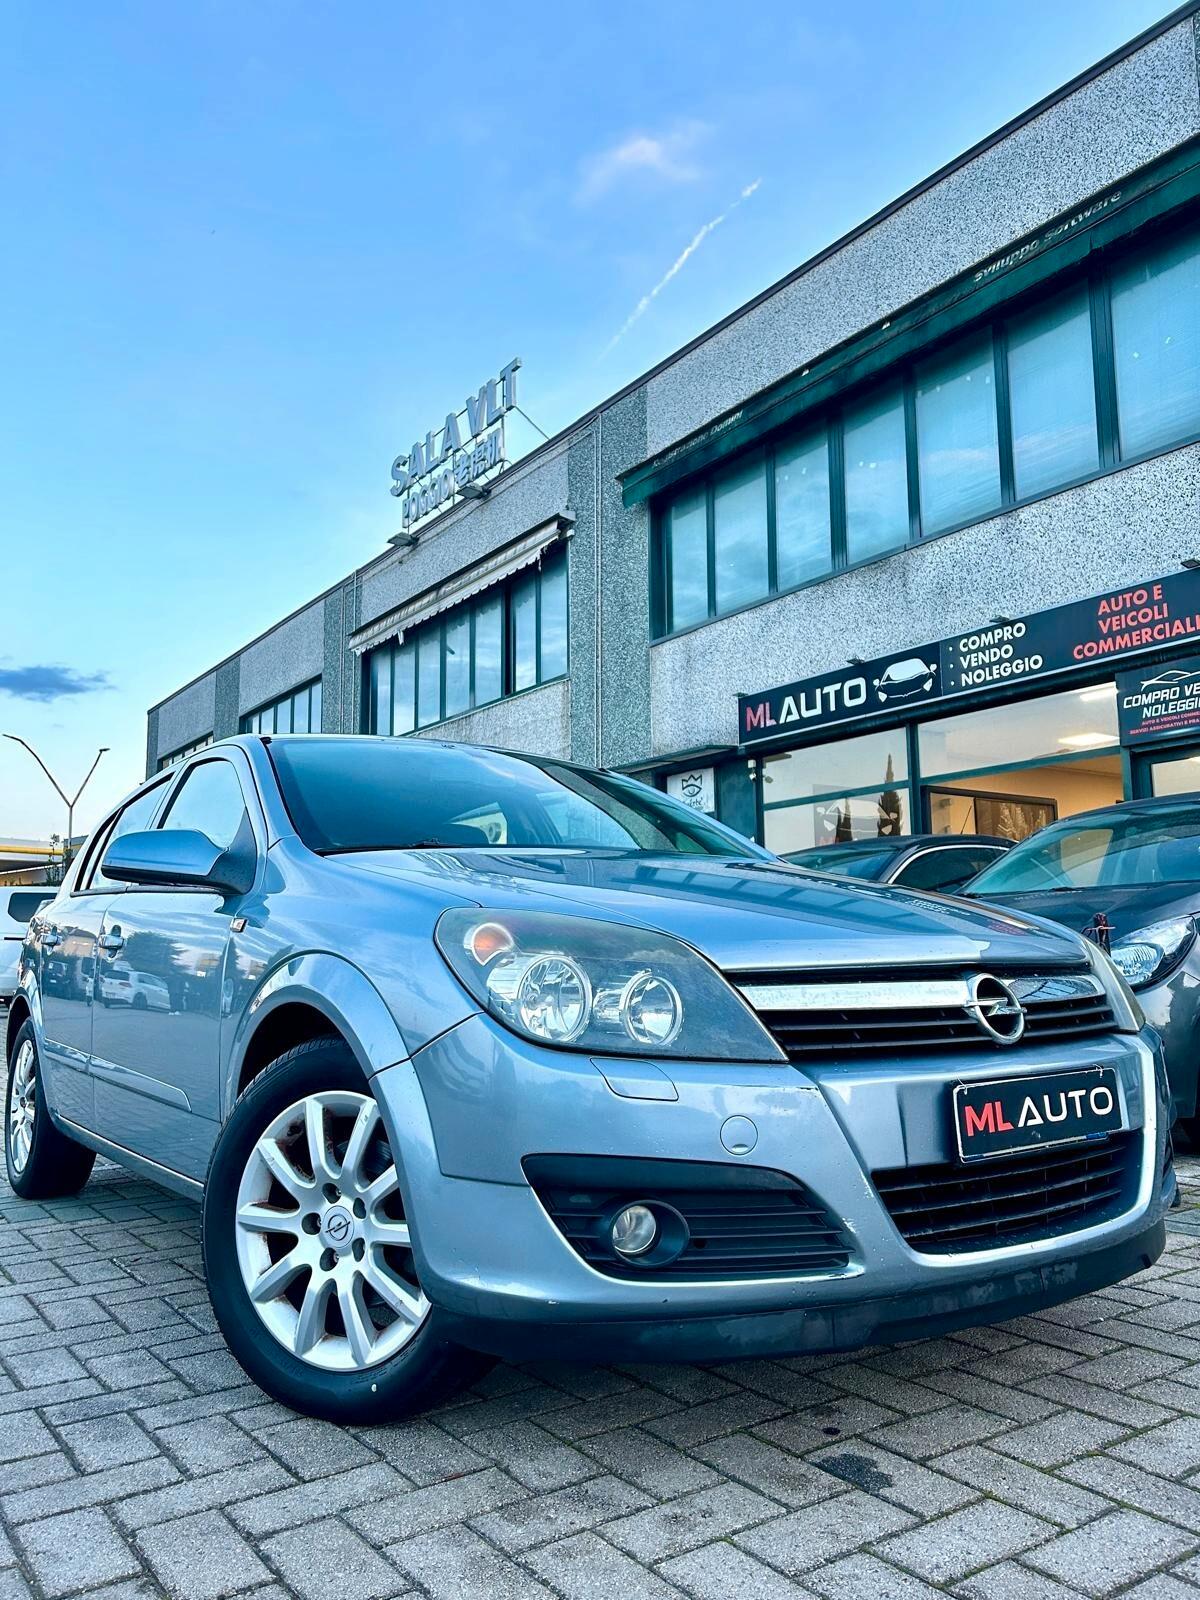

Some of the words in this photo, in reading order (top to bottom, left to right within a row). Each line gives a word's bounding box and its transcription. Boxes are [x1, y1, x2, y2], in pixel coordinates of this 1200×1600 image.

[390, 412, 462, 497] SALA
[466, 357, 522, 438] VLT
[402, 468, 455, 528] POGGIO
[1098, 588, 1148, 616] AUTO
[1153, 584, 1163, 600] E
[1098, 603, 1169, 634] VEICOLI
[959, 622, 1026, 652] COMPRO
[960, 645, 1014, 669] VENDO
[961, 654, 1044, 687] NOLEGGIO
[746, 702, 777, 732] ML
[779, 677, 867, 724] AUTO
[1123, 687, 1180, 709] COMPRO
[964, 1101, 1014, 1137] ML
[1017, 1086, 1113, 1128] AUTO
